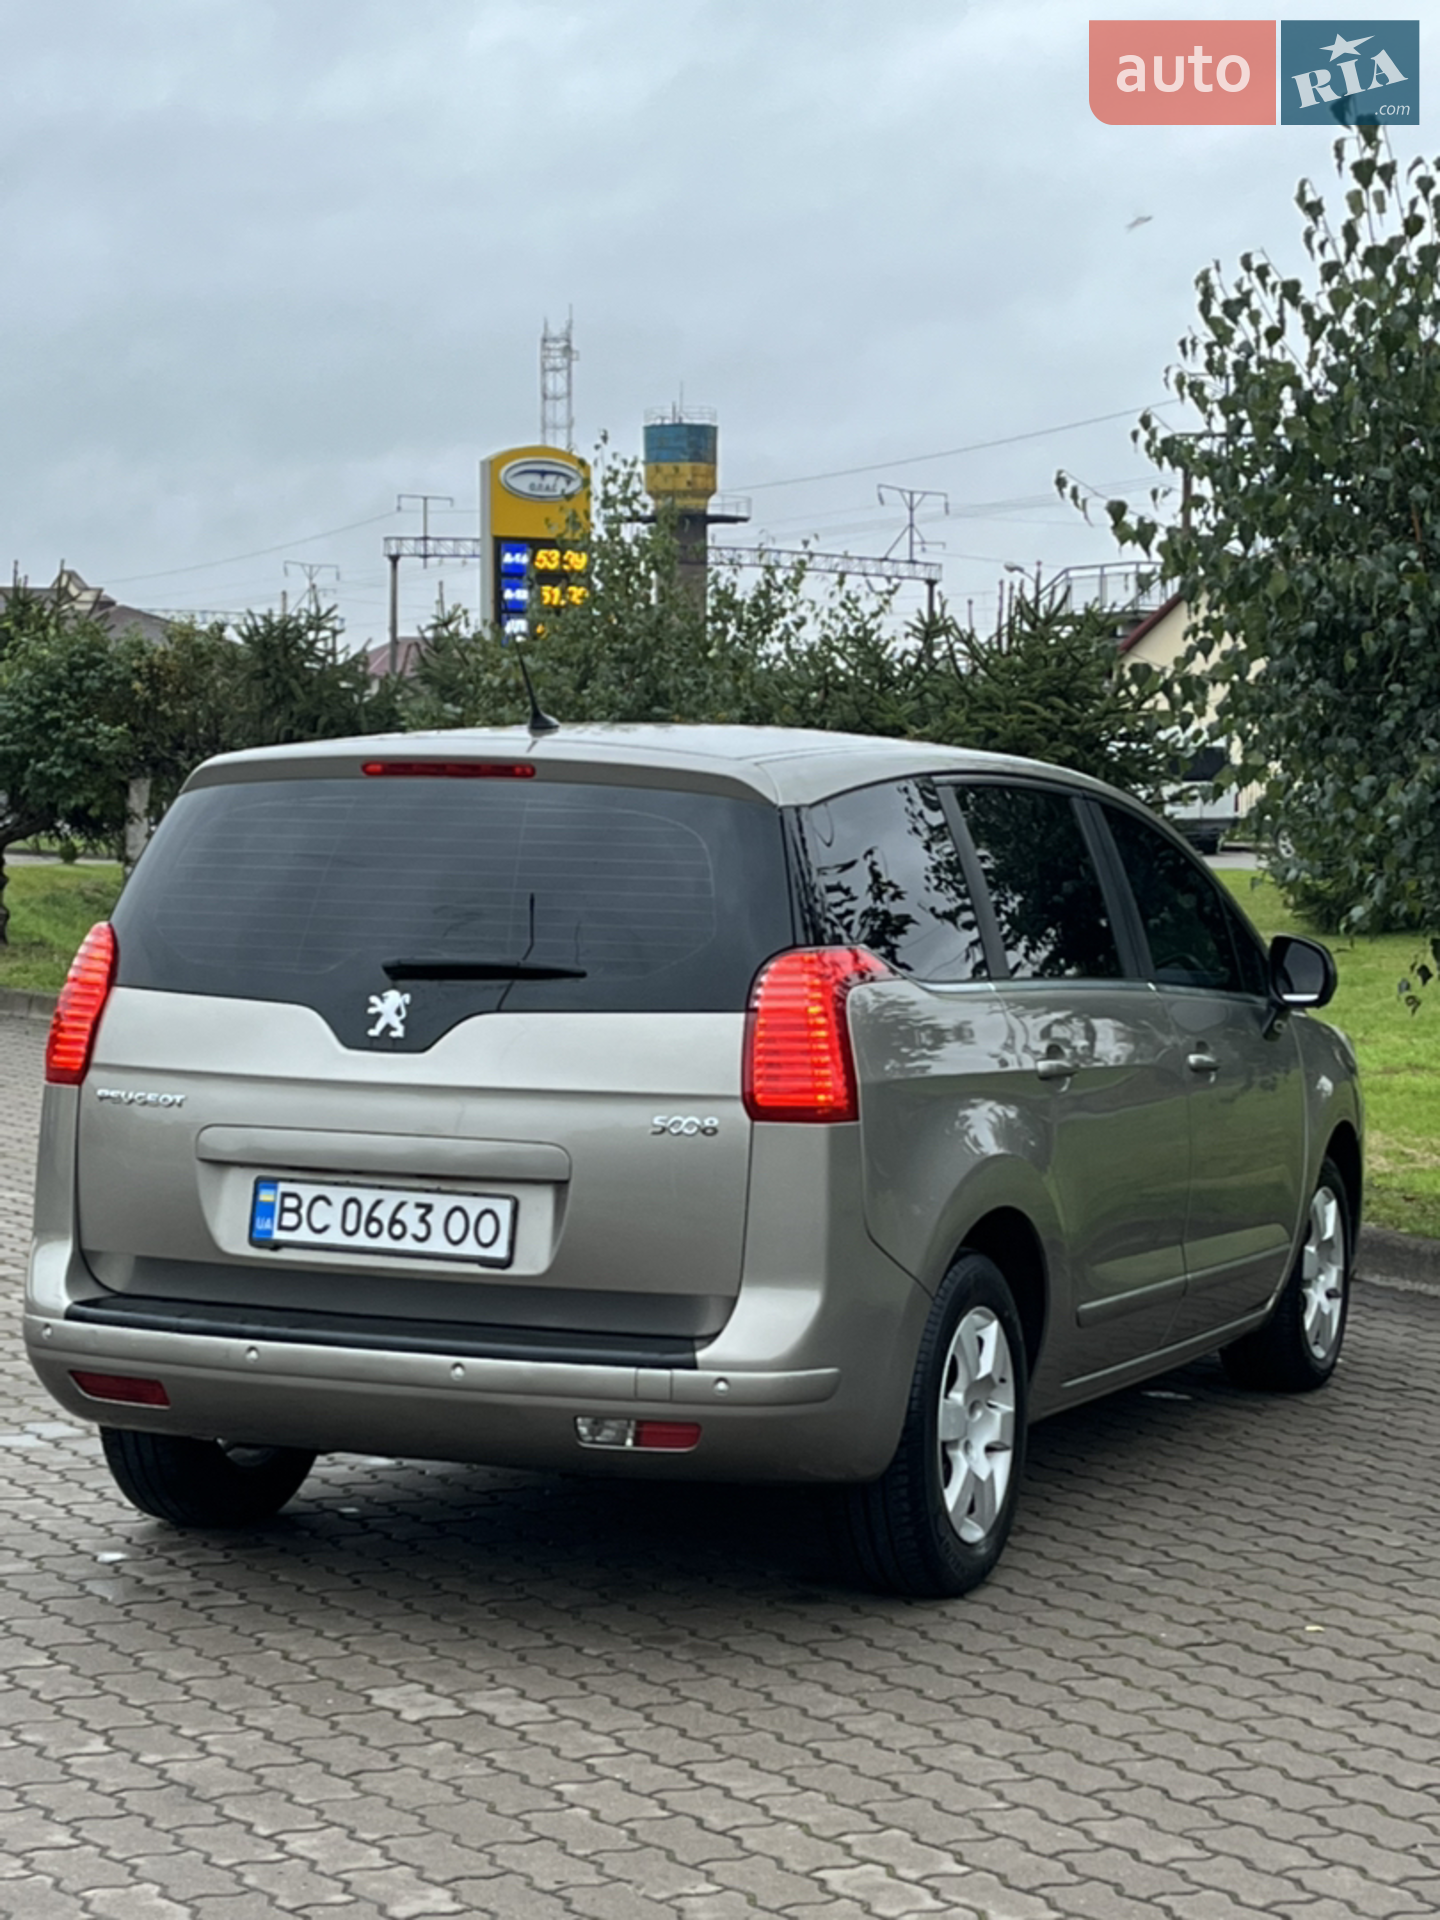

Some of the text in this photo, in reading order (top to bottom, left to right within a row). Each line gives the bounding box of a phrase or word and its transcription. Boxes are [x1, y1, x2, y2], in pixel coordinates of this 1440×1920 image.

[97, 1088, 186, 1108] PEUGEOT
[650, 1115, 719, 1137] 5008
[255, 1216, 273, 1230] UA
